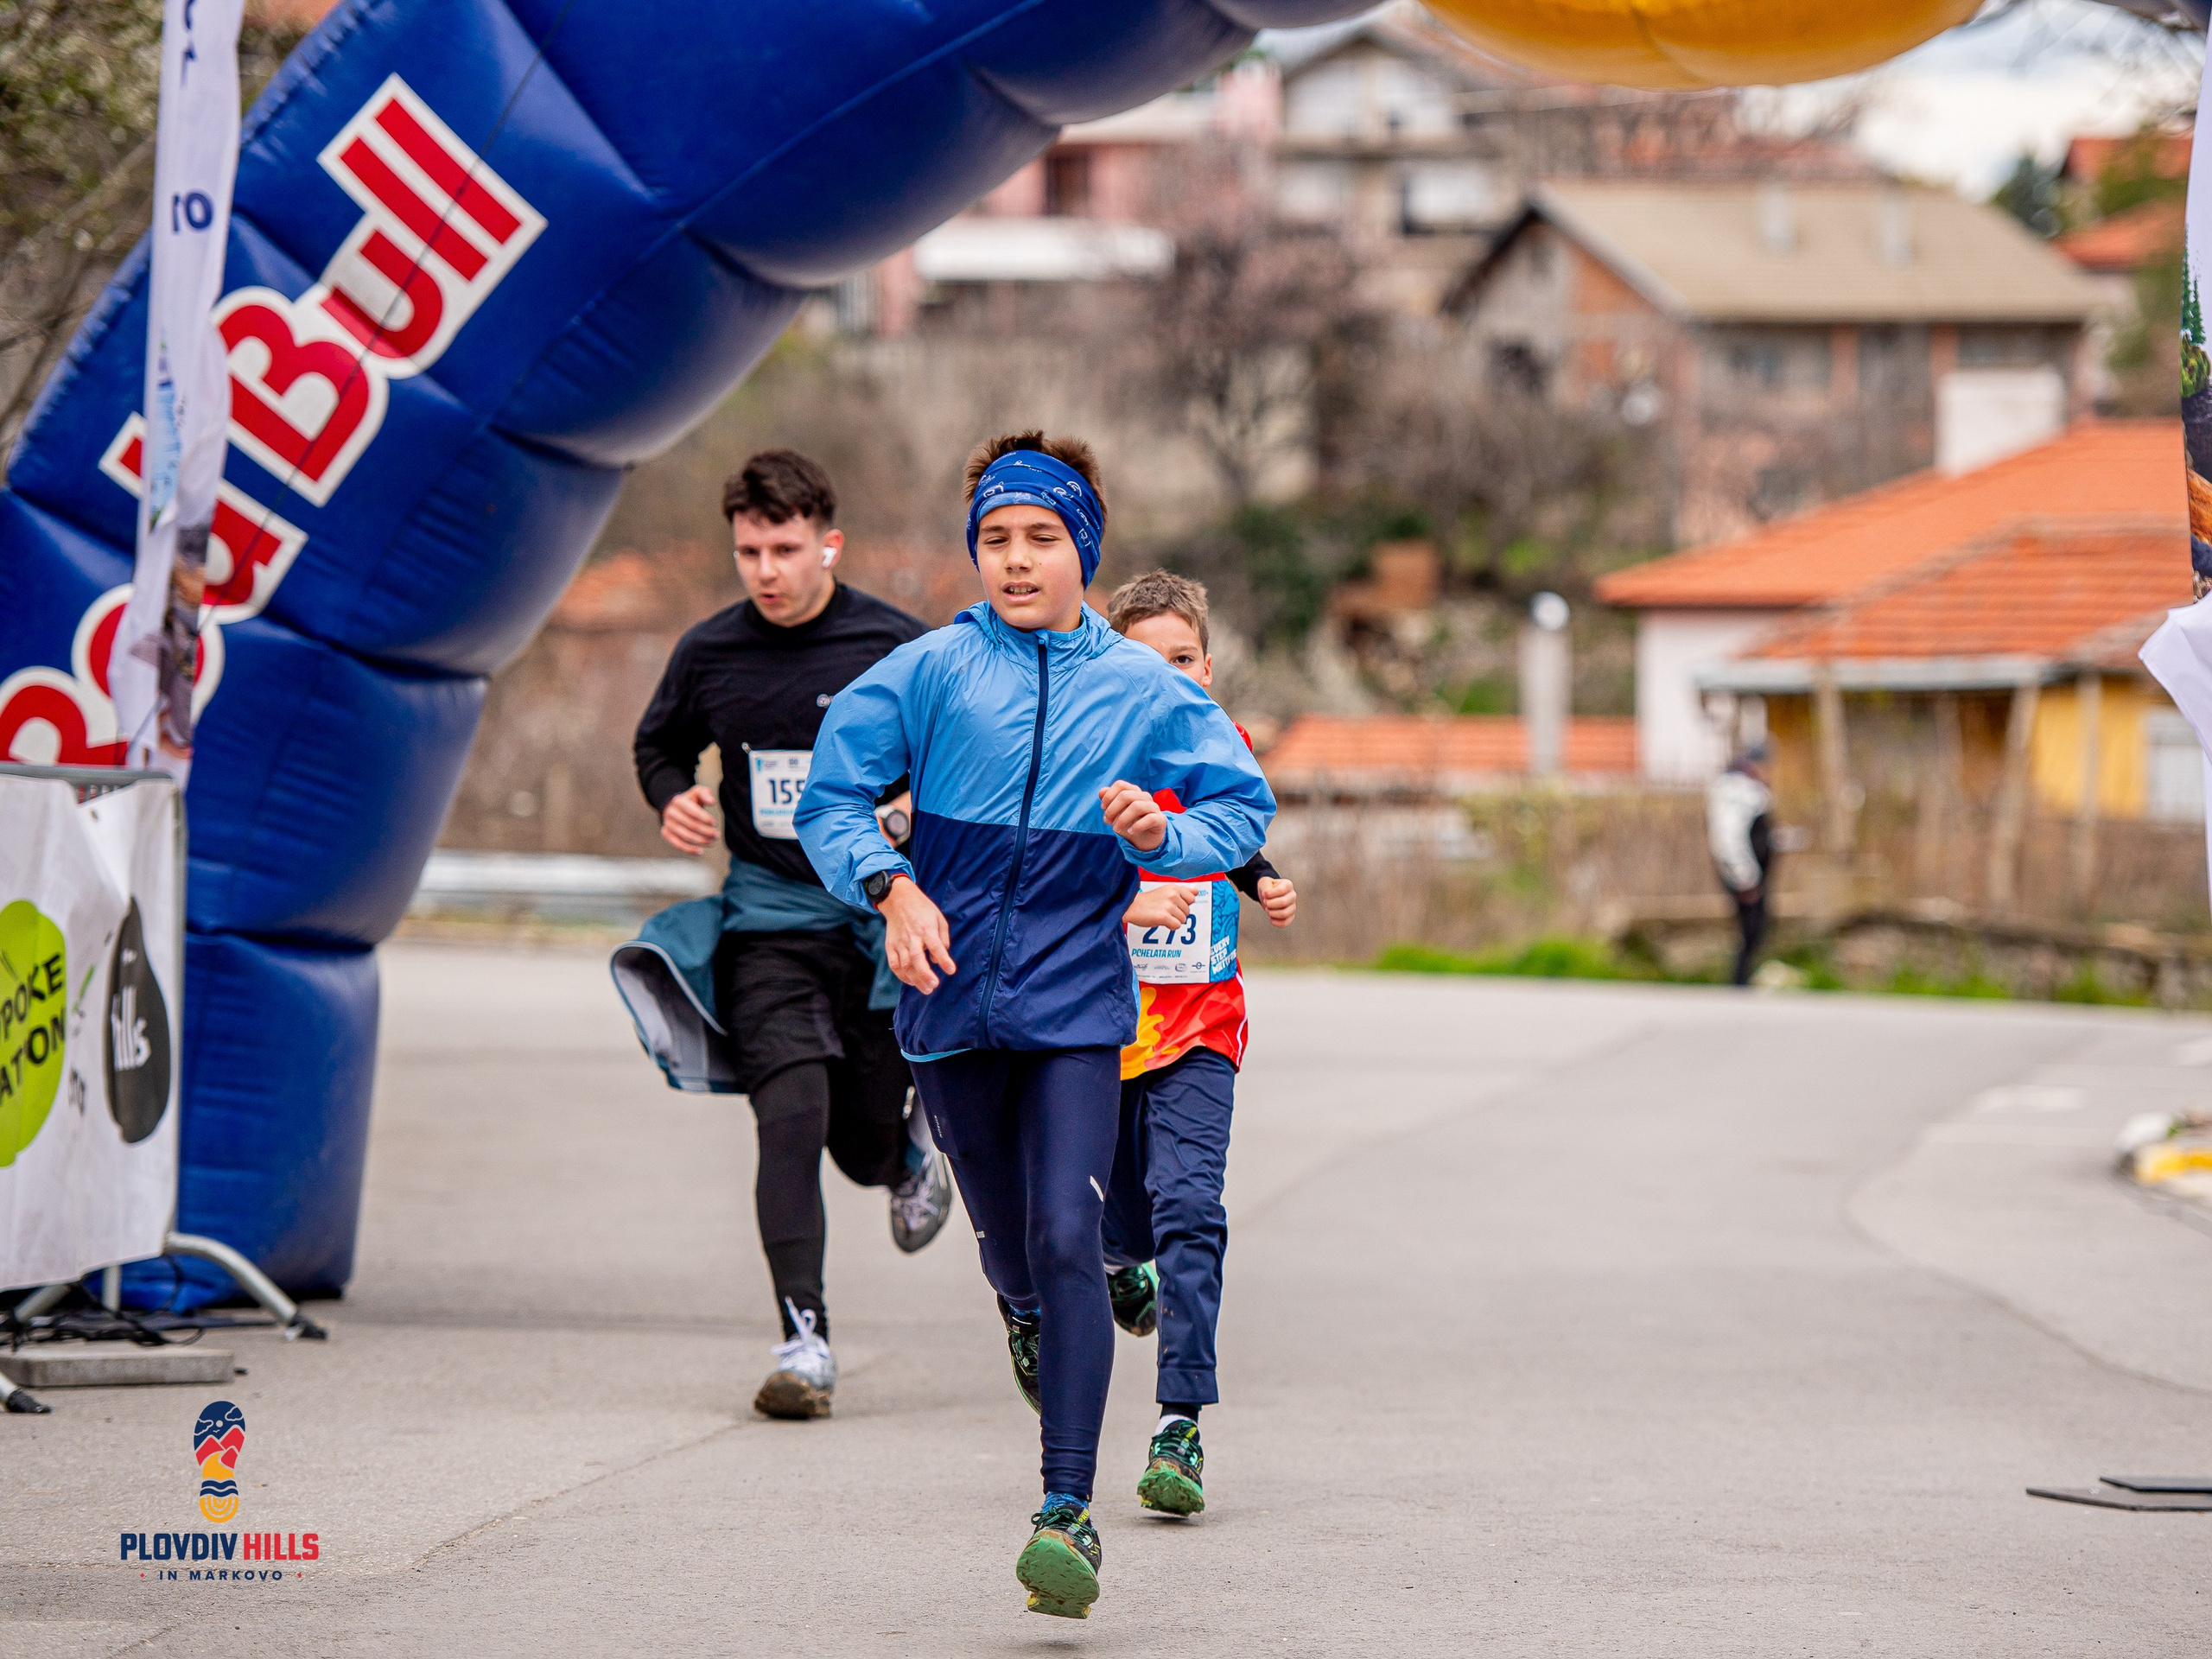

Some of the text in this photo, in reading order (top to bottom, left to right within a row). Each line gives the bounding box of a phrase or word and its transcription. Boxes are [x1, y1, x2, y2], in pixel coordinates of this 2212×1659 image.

[216, 95, 524, 486] Bull
[1131, 948, 1182, 958] PCHELATA RUN
